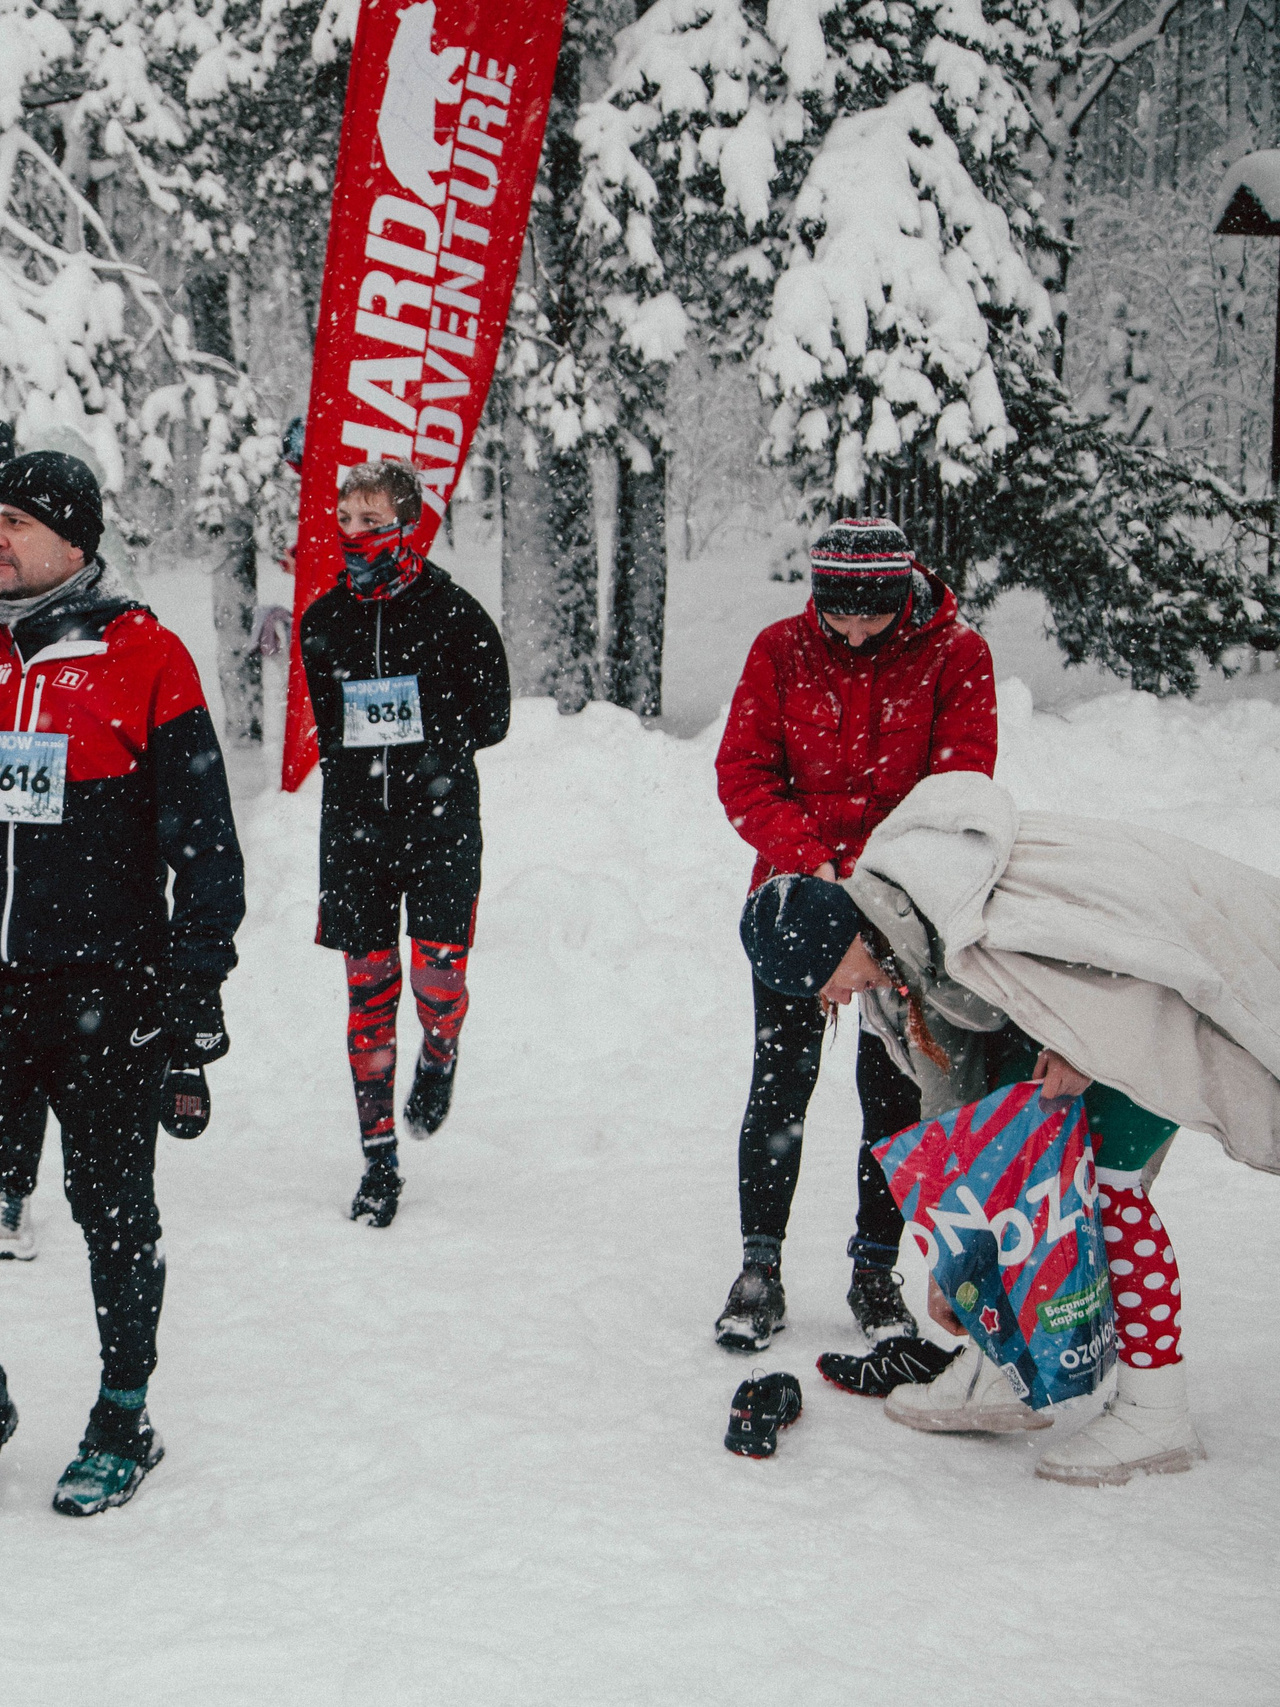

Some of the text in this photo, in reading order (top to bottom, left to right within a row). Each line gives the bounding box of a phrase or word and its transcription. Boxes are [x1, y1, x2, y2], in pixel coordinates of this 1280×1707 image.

[336, 193, 442, 489] HARD
[415, 49, 517, 517] ADVENTURE
[367, 700, 412, 724] 836
[1049, 1306, 1085, 1328] карта
